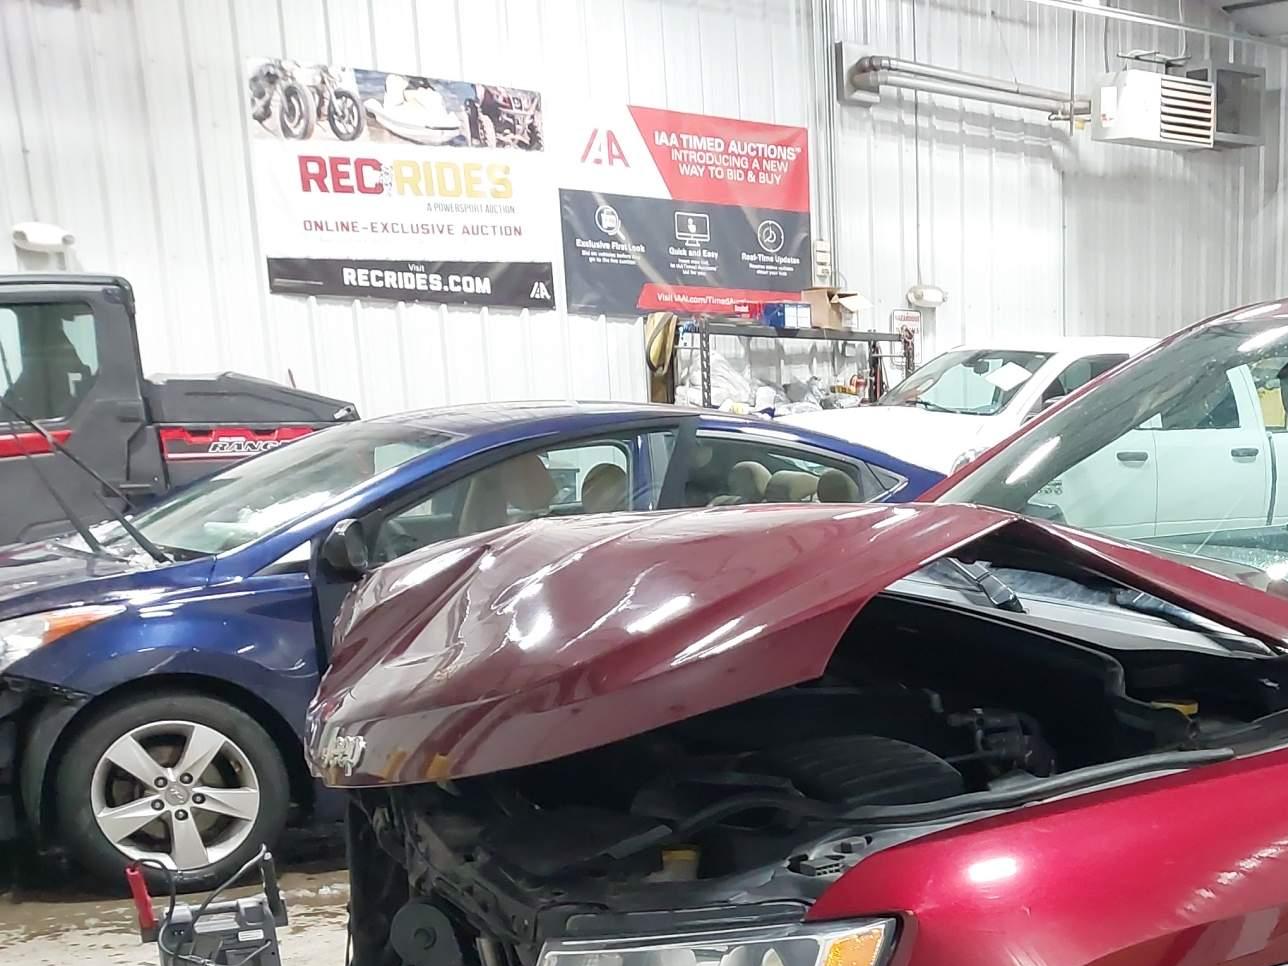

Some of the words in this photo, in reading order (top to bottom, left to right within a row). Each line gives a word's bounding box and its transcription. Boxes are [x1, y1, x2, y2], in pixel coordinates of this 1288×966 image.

[654, 131, 679, 148] IAA
[679, 134, 725, 151] TIMED
[671, 149, 749, 169] INTRODUCING
[751, 156, 761, 170] A
[762, 158, 789, 174] NEW
[297, 155, 384, 195] REC
[392, 158, 514, 199] RIDES
[678, 163, 705, 176] WAY
[707, 166, 725, 180] TO
[726, 168, 745, 182] BID
[746, 169, 756, 183] &
[758, 171, 782, 185] BUY
[426, 203, 434, 213] A
[433, 203, 484, 214] POWERSPORT
[485, 204, 516, 216] AUCTION
[303, 219, 456, 235] ONLINE-EXCLUSIVE
[461, 223, 523, 237] AUCTION
[575, 238, 611, 250] Exclusive
[611, 241, 628, 252] First
[668, 246, 687, 257] Quick
[688, 248, 702, 257] and
[702, 249, 719, 260] Easy
[741, 252, 774, 263] Real-Time
[774, 255, 801, 265] Updates
[407, 264, 425, 272] Visit
[342, 267, 492, 294] RECRIDES.COM
[656, 293, 673, 302] Visit
[208, 439, 292, 453] RANG
